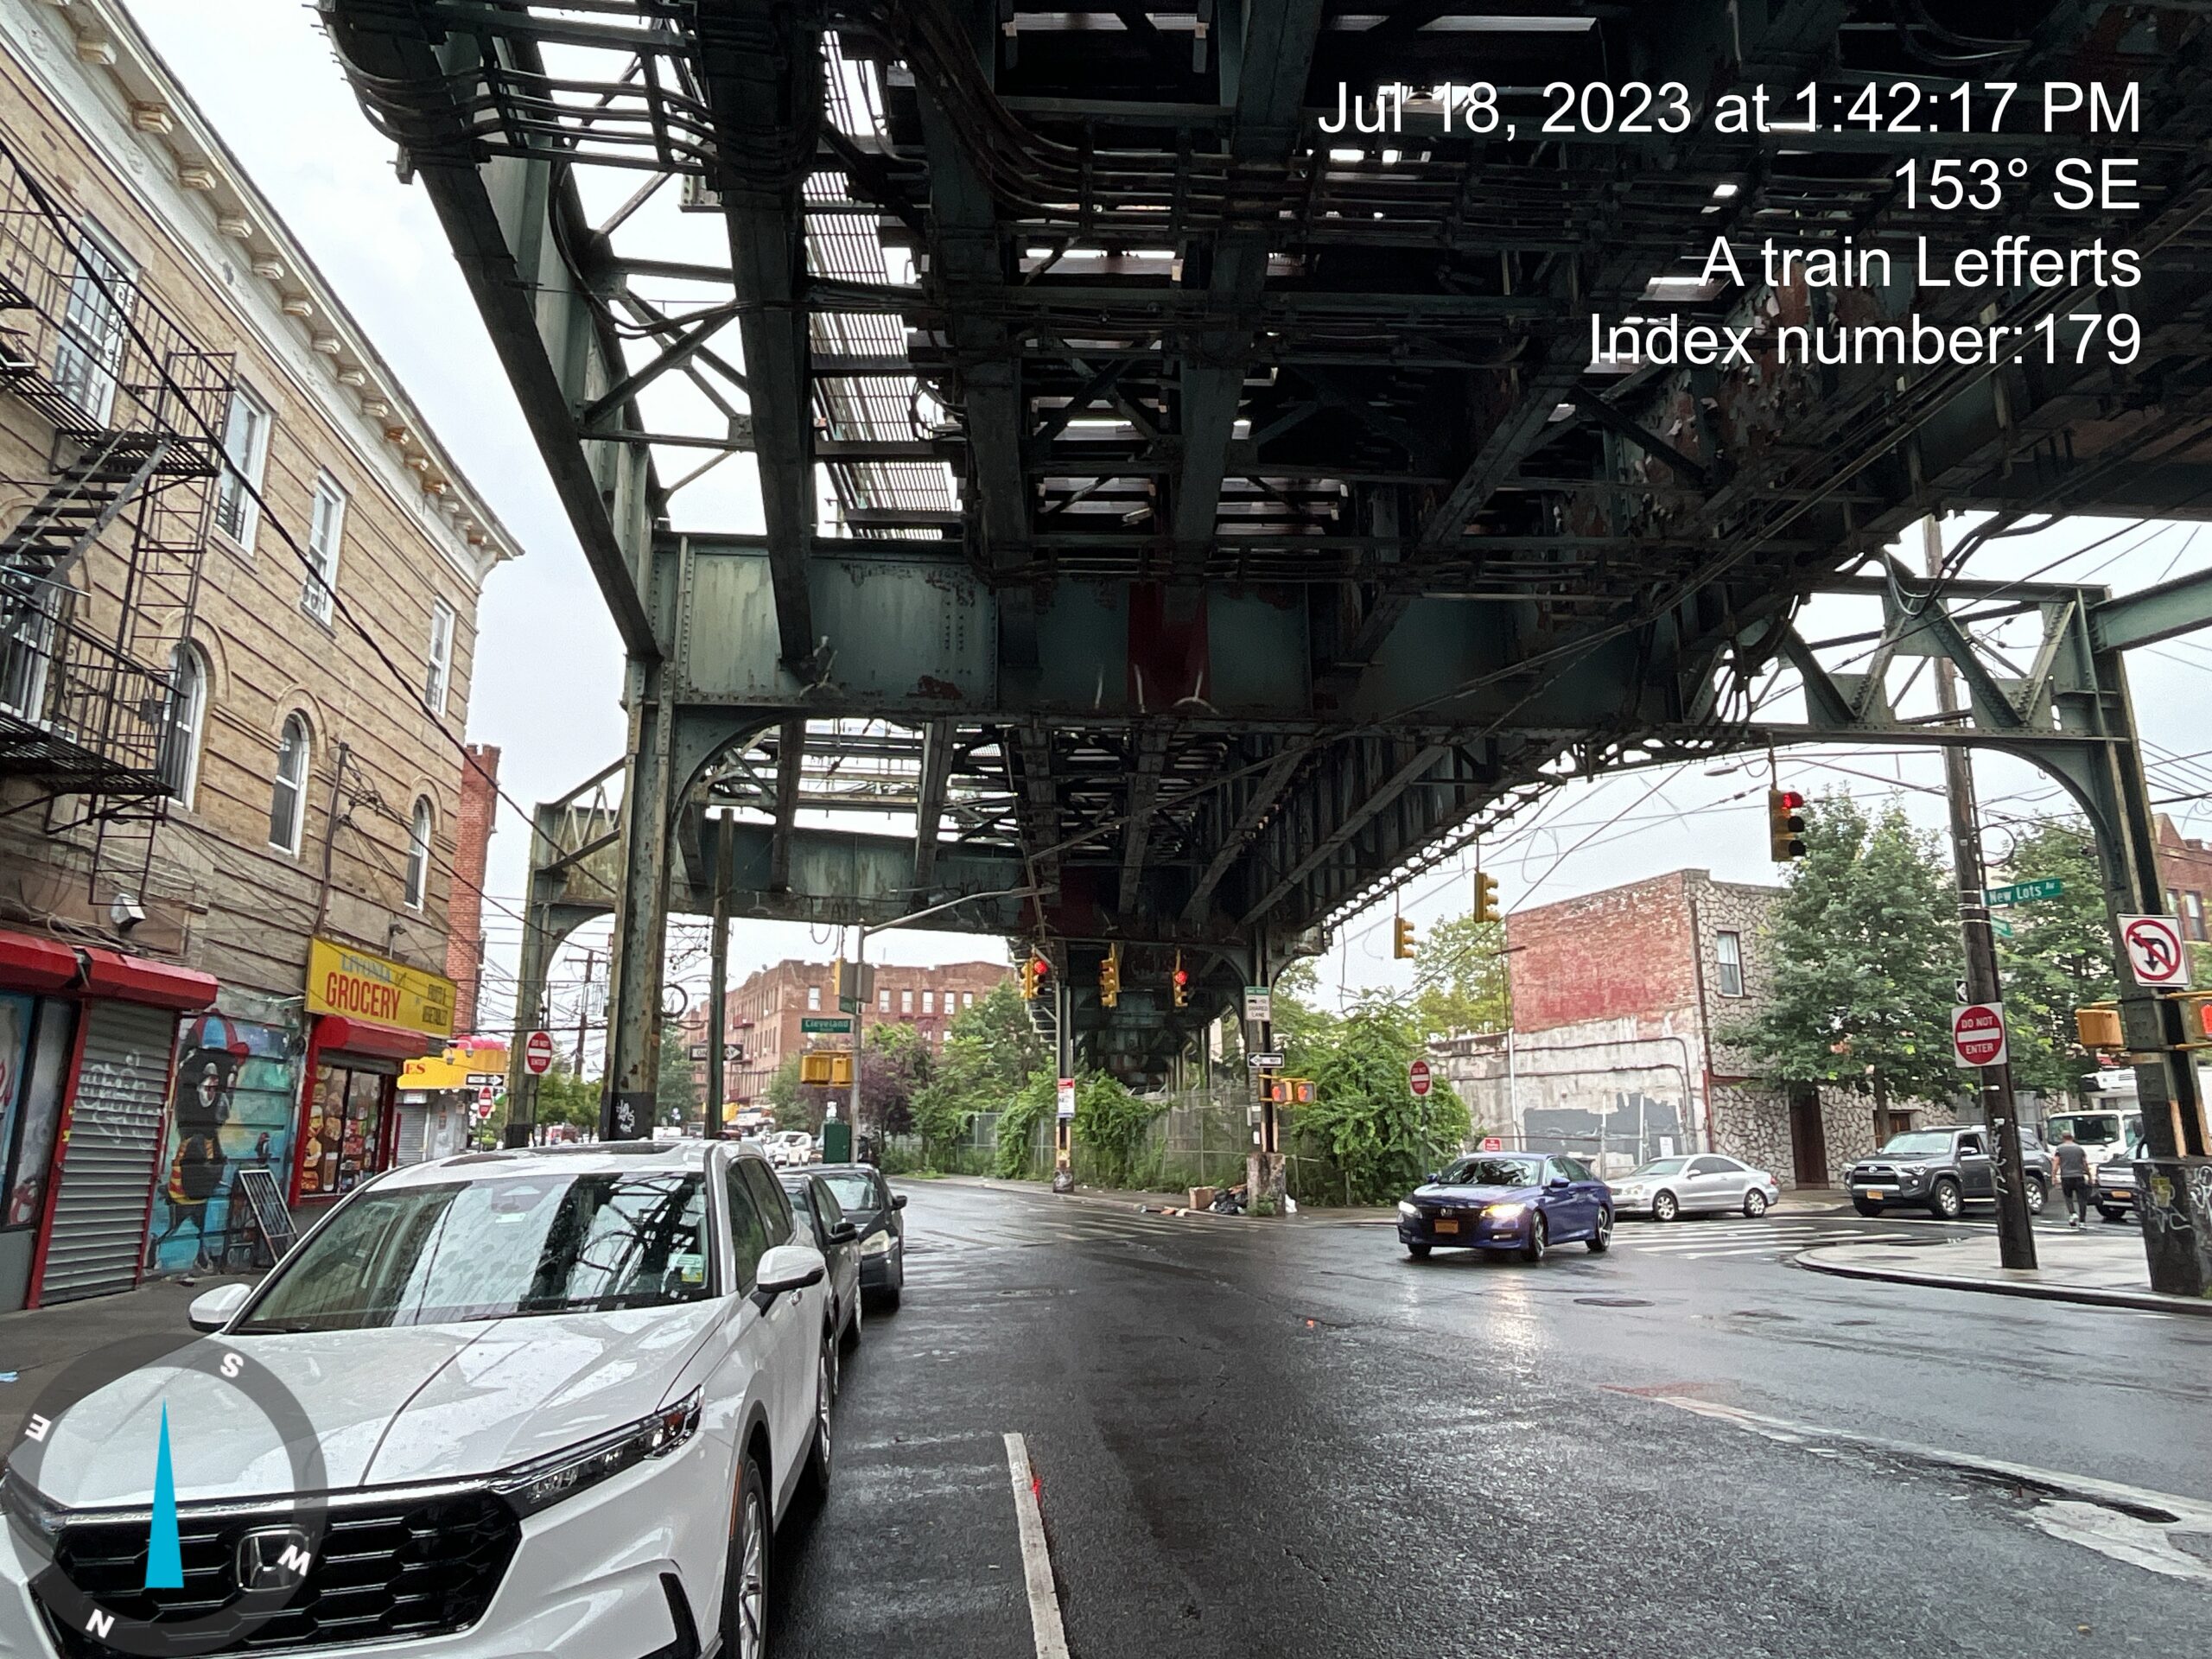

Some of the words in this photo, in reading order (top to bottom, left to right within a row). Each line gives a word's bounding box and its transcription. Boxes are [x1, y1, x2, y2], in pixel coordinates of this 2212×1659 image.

[1989, 891, 2012, 904] New
[2016, 884, 2043, 899] Lots
[327, 972, 401, 1020] GROCERY
[804, 1020, 849, 1029] Cleveland
[1961, 1019, 1973, 1028] DO
[1976, 1016, 1993, 1027] NOT
[1966, 1043, 1993, 1054] ENTER
